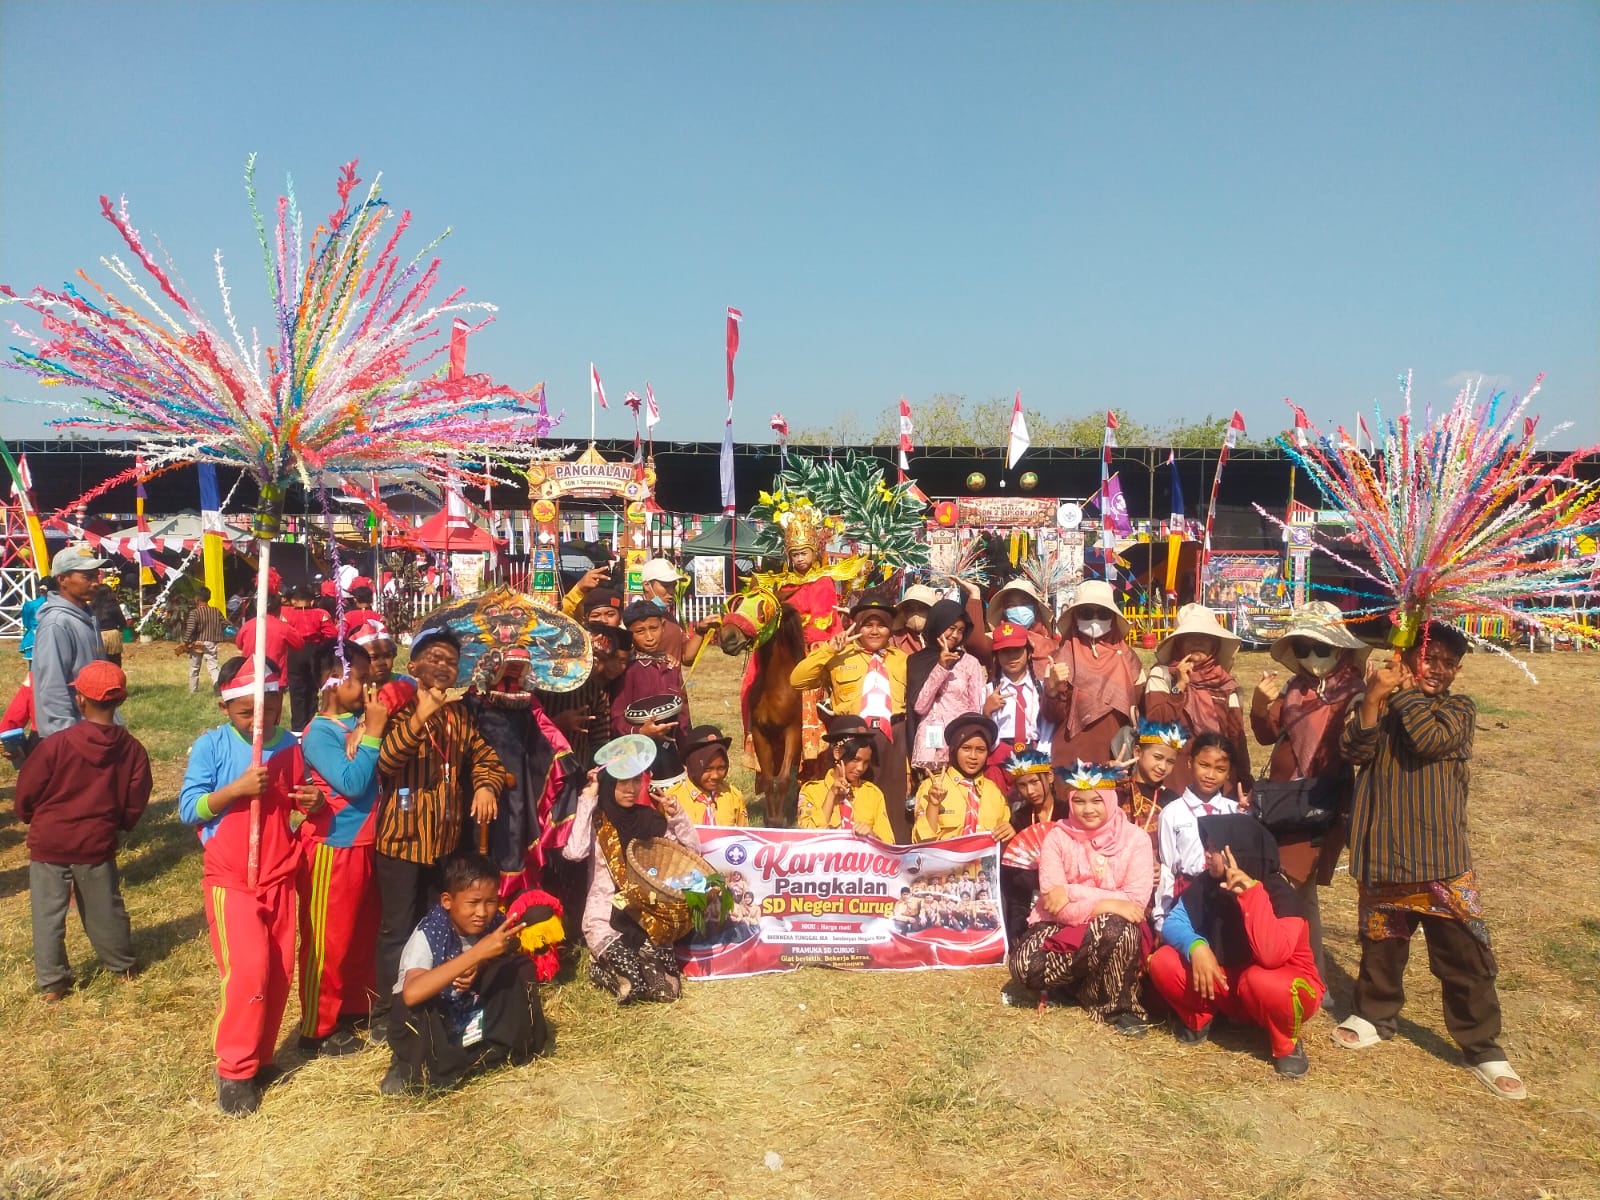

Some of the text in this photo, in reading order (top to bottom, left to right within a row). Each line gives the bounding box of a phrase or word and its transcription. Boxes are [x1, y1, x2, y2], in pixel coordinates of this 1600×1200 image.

[556, 465, 631, 479] PANGKALAN
[1222, 568, 1264, 578] GARUDA
[1248, 607, 1259, 615] SDN
[775, 878, 887, 897] Pangkalan
[762, 897, 894, 917] SD Negeri Curug
[791, 946, 823, 954] PRAMUKA
[823, 946, 832, 954] SD
[833, 946, 855, 954] CURUG
